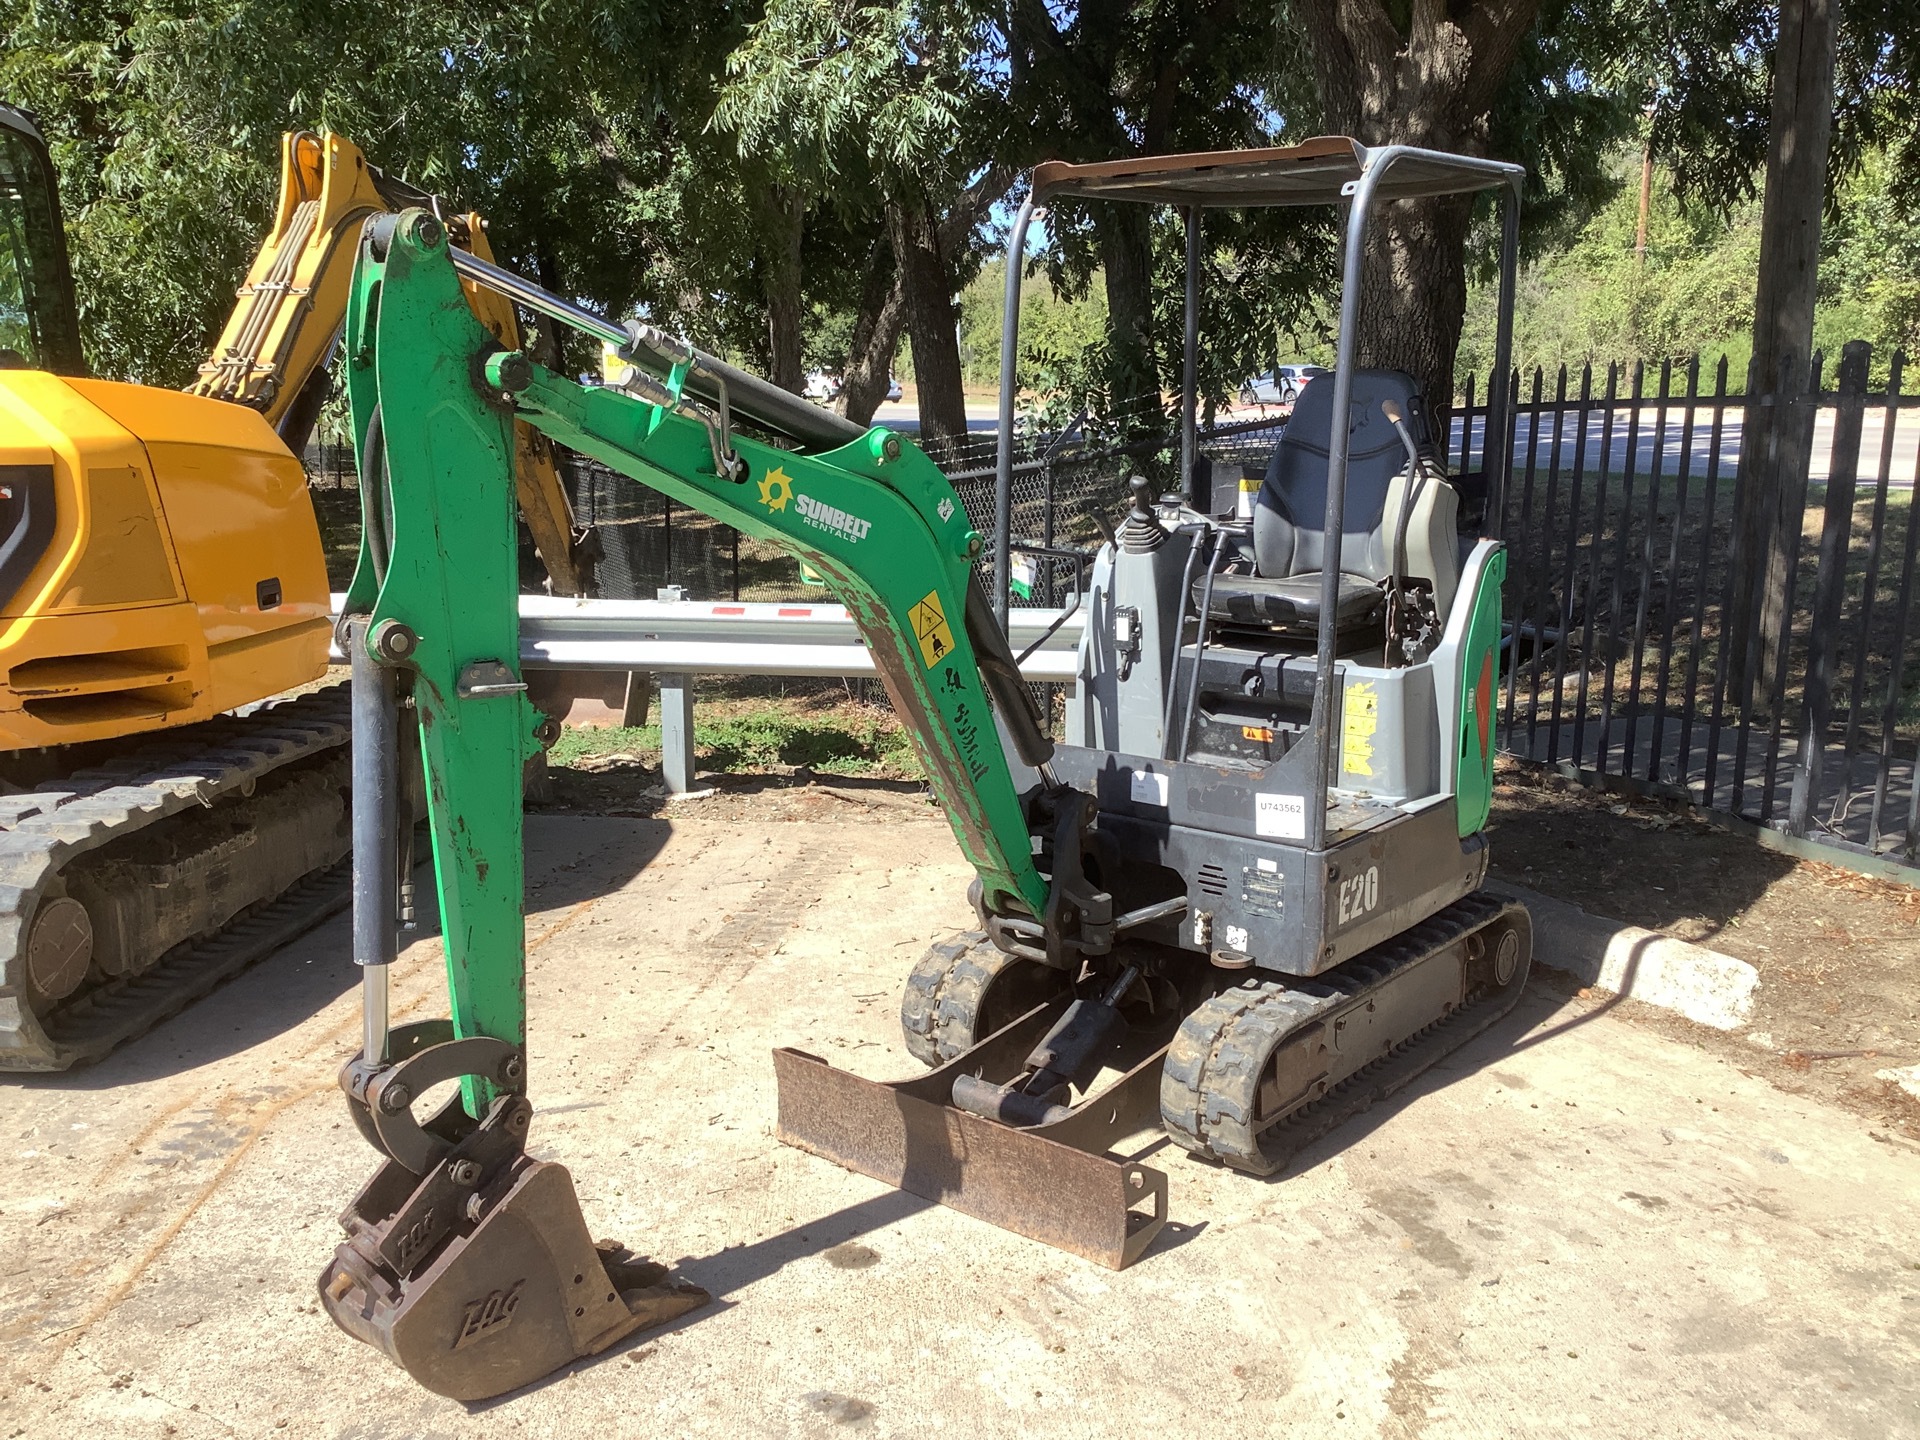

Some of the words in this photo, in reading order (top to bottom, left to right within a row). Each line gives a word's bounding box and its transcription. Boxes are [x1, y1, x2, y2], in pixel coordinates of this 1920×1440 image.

[794, 493, 872, 540] SUNBELT
[802, 516, 857, 544] RENTALS
[1260, 802, 1302, 814] U743562
[1338, 865, 1379, 926] E20
